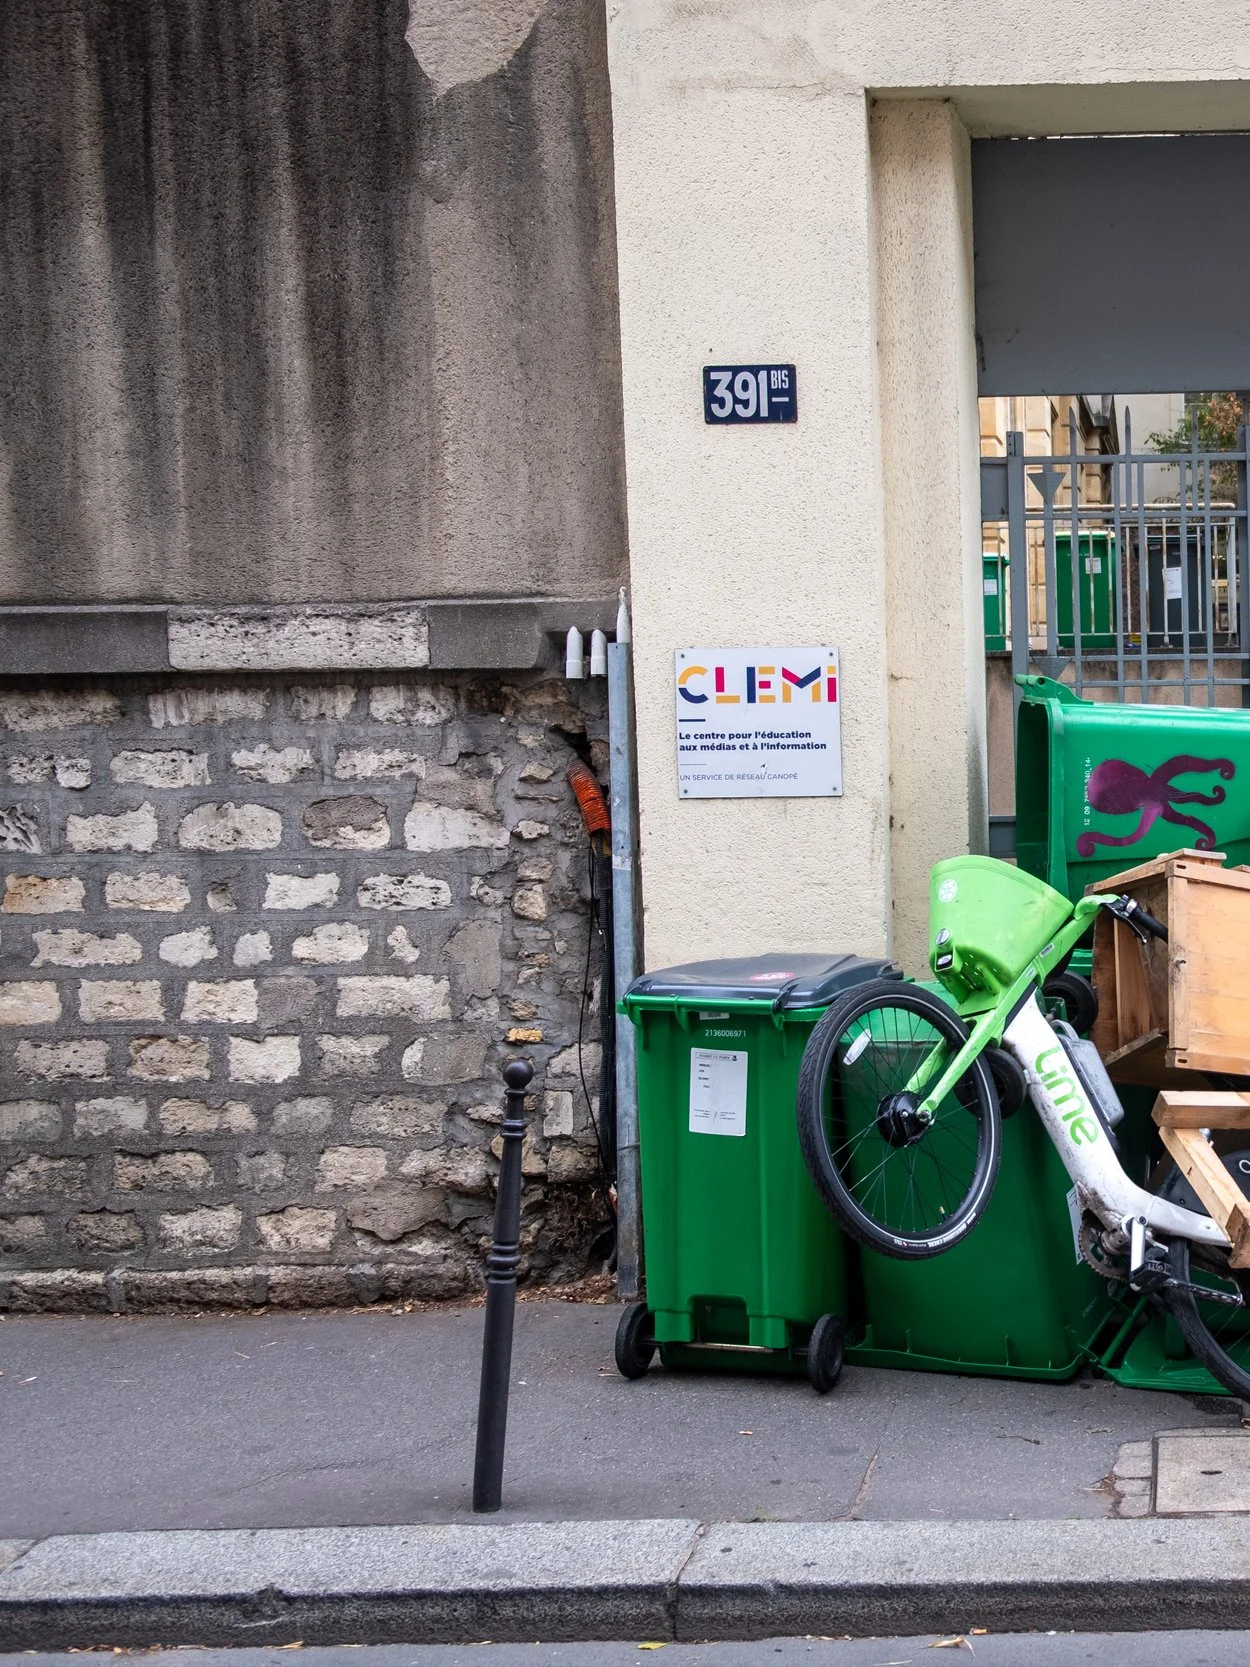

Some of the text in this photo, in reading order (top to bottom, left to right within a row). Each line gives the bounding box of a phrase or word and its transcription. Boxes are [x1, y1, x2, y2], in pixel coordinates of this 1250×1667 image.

[710, 369, 789, 418] 391 BIS
[679, 731, 812, 741] Le centre pour l'éducation
[679, 741, 827, 752] aux médias et à l'information
[736, 772, 766, 780] RÉSEAU
[704, 1029, 746, 1038] 2136006971
[1035, 1045, 1099, 1146] Lime
